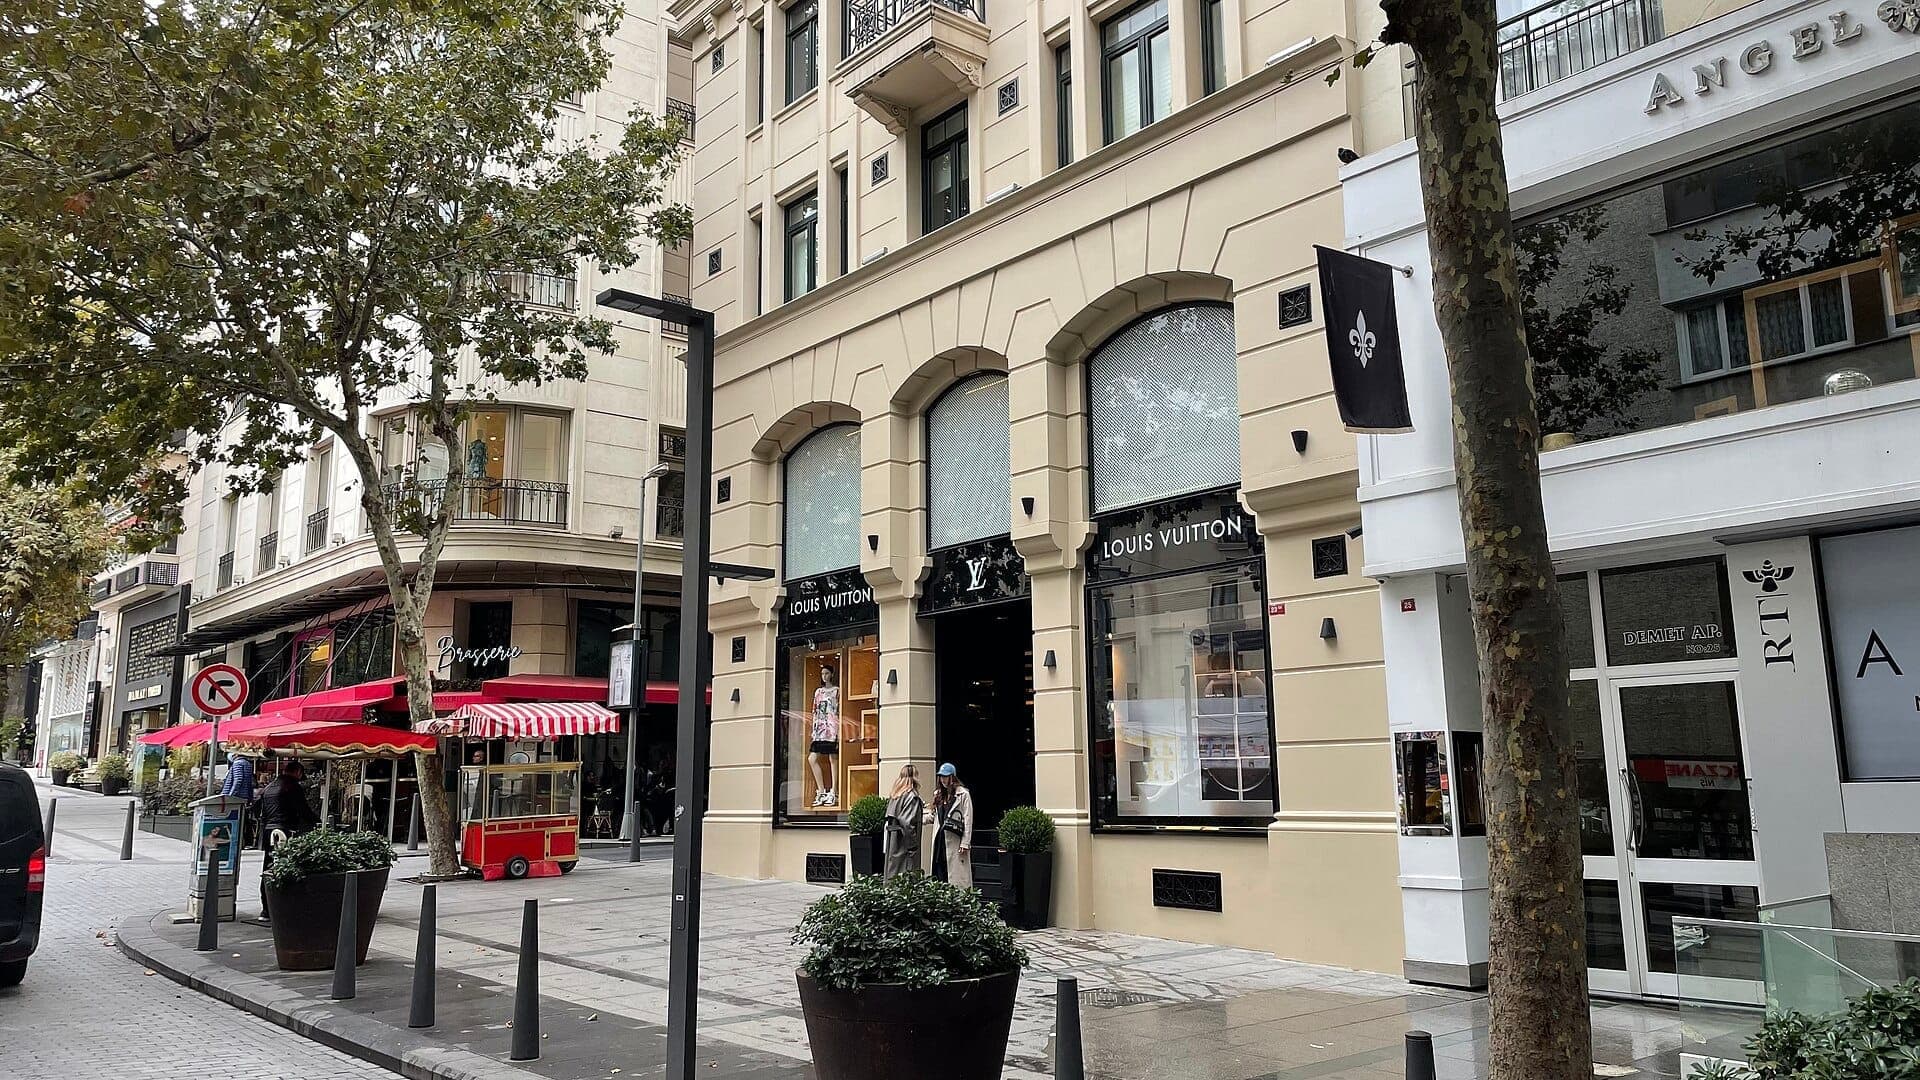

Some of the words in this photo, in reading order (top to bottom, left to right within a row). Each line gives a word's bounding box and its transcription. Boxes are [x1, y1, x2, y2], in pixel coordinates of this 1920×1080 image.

[1103, 532, 1154, 559] LOUIS
[1159, 515, 1242, 548] VUITTON
[790, 597, 820, 616] LOUIS
[823, 587, 871, 610] VUITTON
[1623, 626, 1685, 646] DEMET
[1691, 623, 1722, 640] AP.
[436, 635, 523, 673] Brasserie
